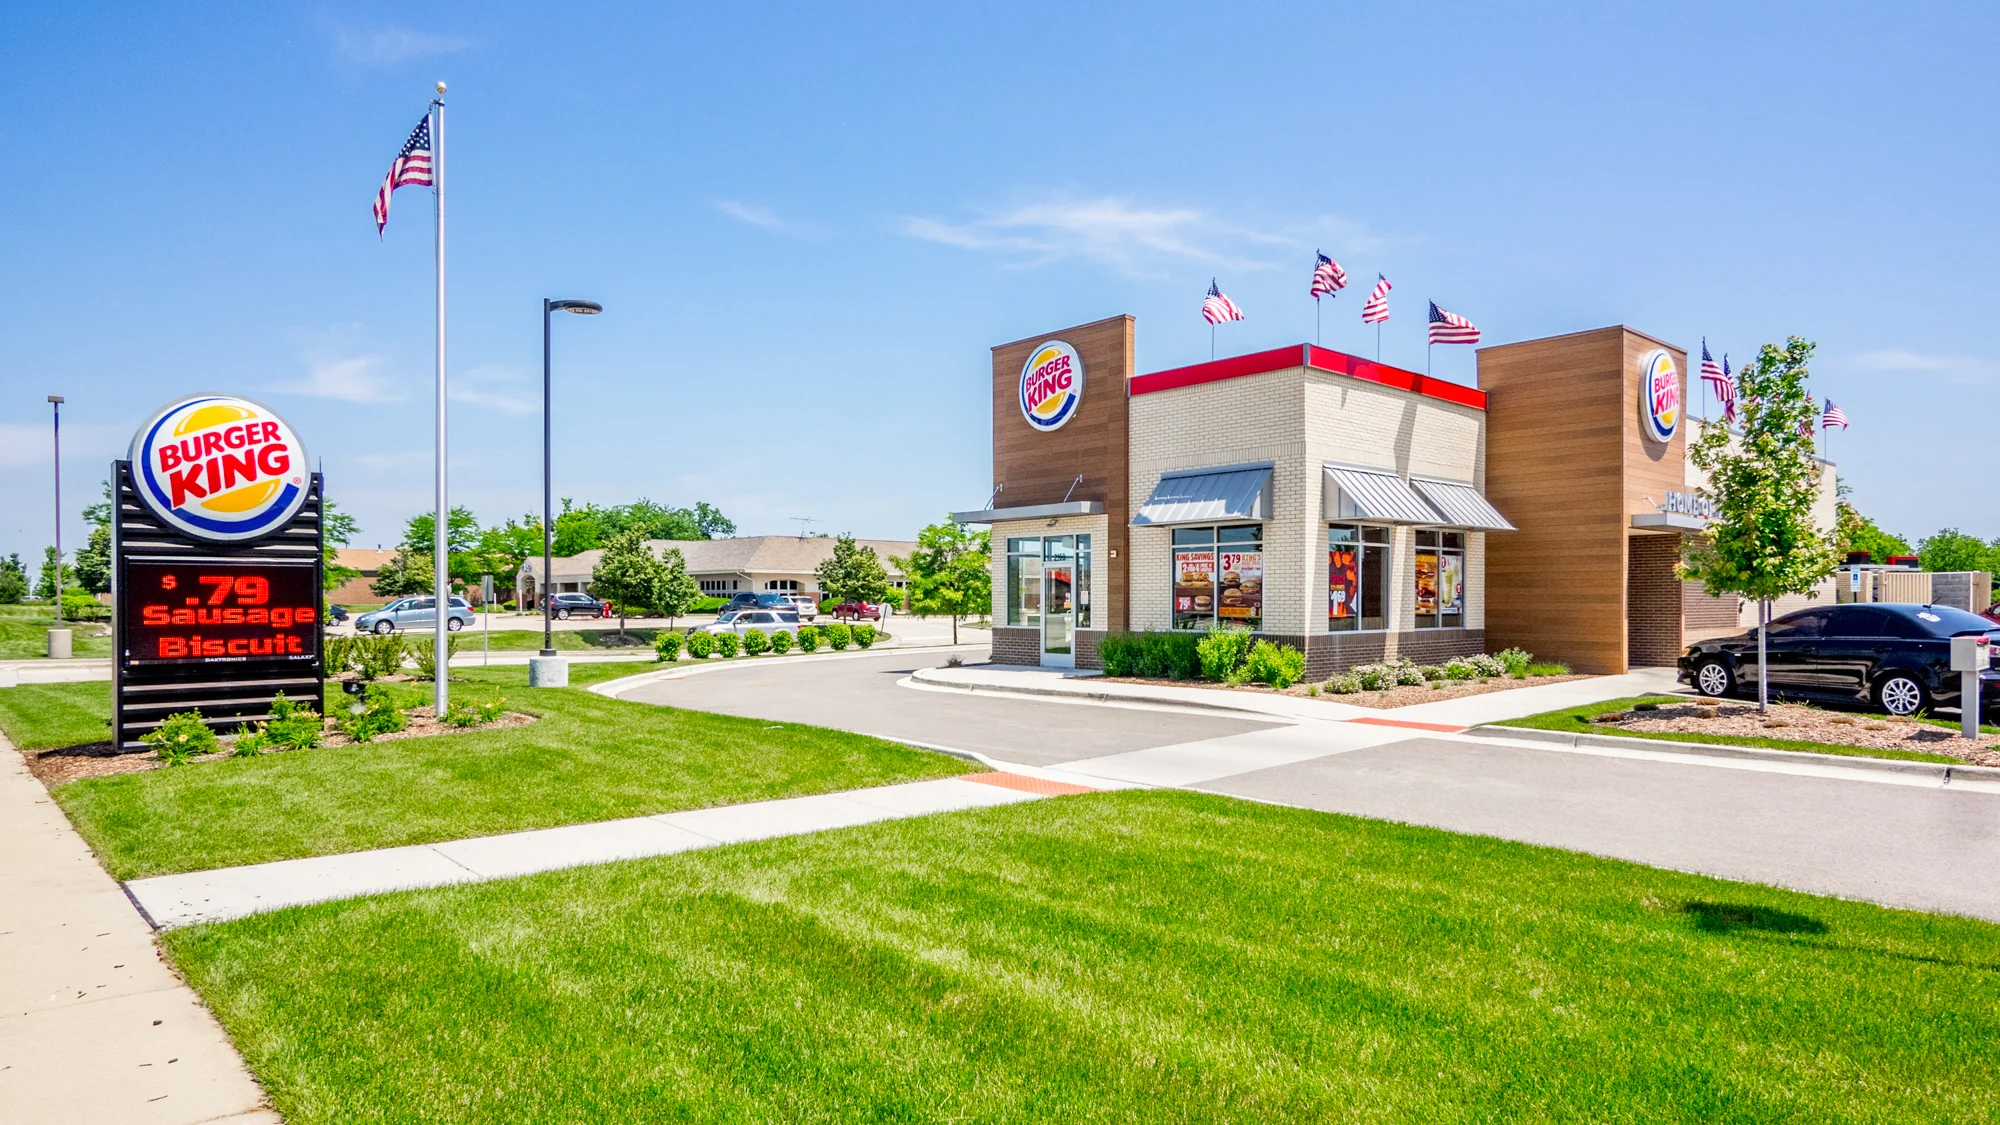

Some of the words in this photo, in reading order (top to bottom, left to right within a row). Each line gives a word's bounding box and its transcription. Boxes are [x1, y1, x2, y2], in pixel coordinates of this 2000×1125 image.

[1026, 355, 1070, 393] BURGER
[1654, 371, 1679, 394] BURGE
[1027, 368, 1072, 413] KING
[158, 421, 282, 473] BURGER
[168, 443, 290, 509] KING
[1666, 491, 1700, 516] HOME
[143, 605, 315, 628] Sausage
[159, 633, 303, 658] Biscuit
